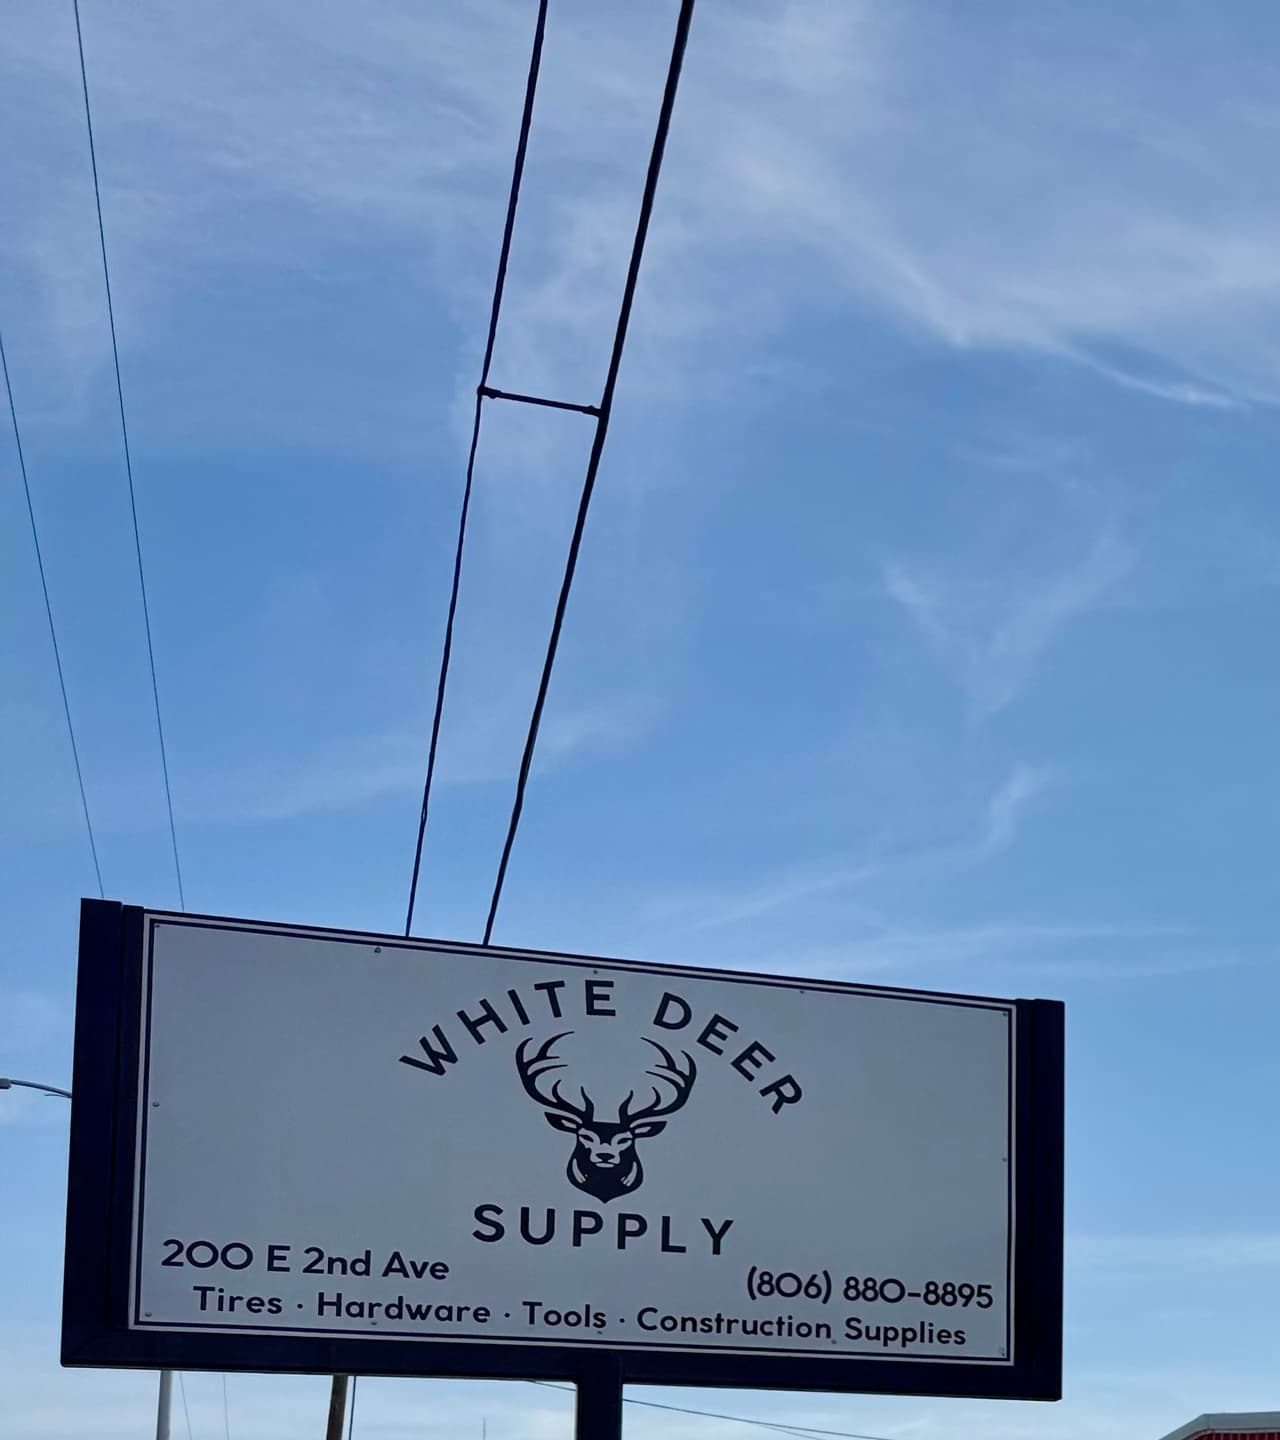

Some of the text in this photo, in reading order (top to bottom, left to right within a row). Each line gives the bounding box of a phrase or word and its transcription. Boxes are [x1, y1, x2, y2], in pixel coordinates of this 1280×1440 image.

[398, 979, 803, 1116] WHITE DEER
[472, 1203, 735, 1256] SUPPLY
[160, 1238, 450, 1281] 200 E 2nd Ave
[746, 1265, 994, 1309] (806) 880-8895
[192, 1285, 967, 1349] Tires Hardware Tools Construction Supplies
